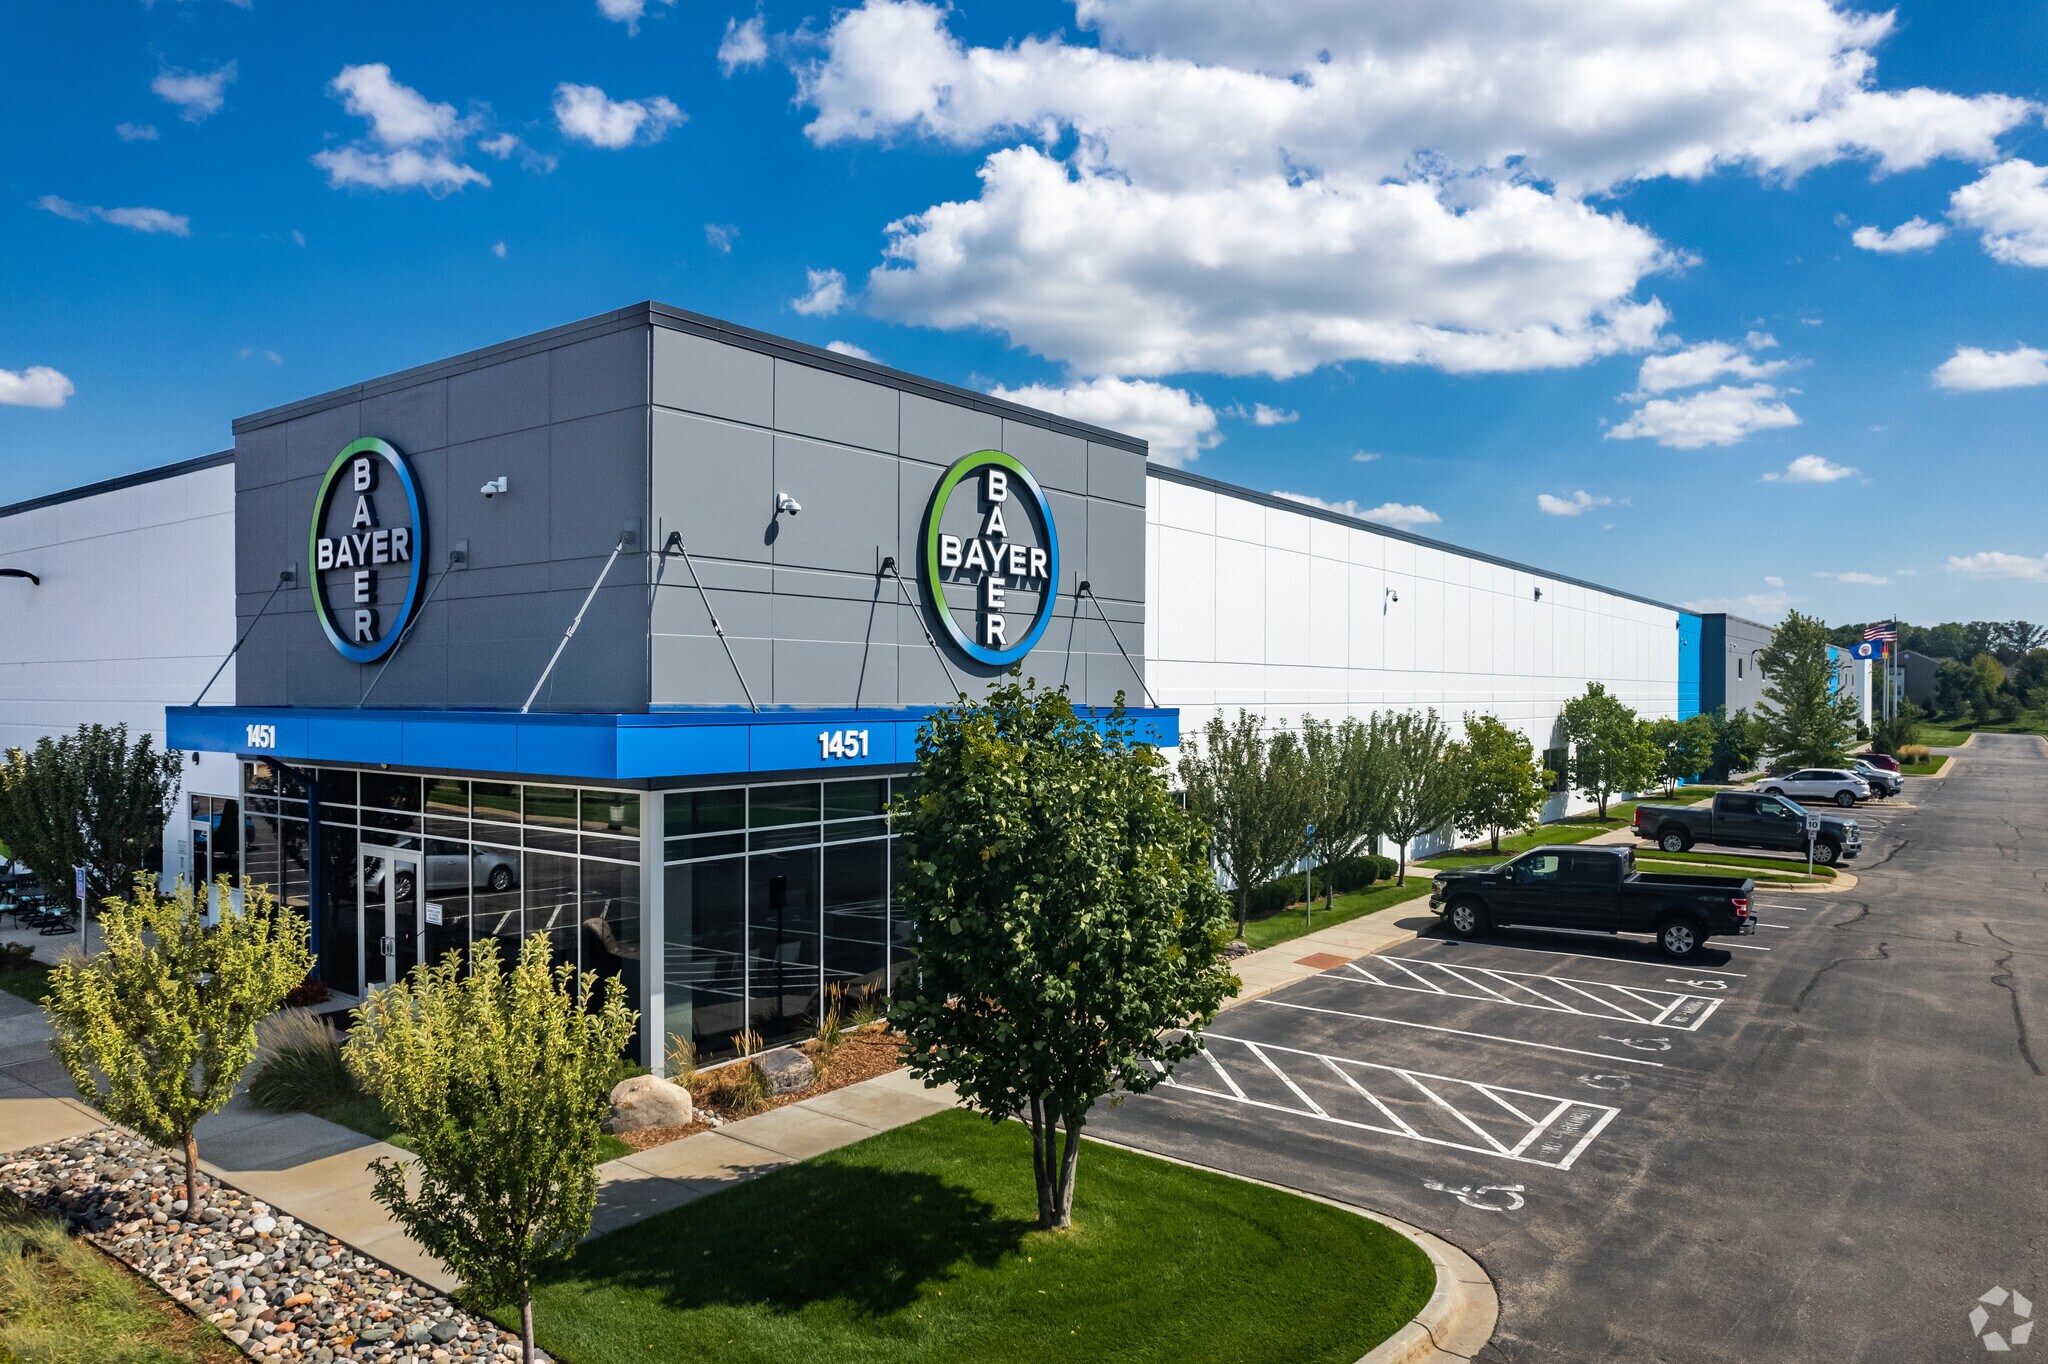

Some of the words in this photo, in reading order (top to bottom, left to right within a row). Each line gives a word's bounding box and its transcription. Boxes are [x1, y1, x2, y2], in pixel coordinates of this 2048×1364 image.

[317, 527, 410, 570] BAYER
[352, 458, 374, 642] BAYER
[940, 533, 1049, 579] BAYER
[985, 469, 1018, 645] BAYER
[246, 724, 276, 749] 1451
[819, 729, 869, 759] 1451
